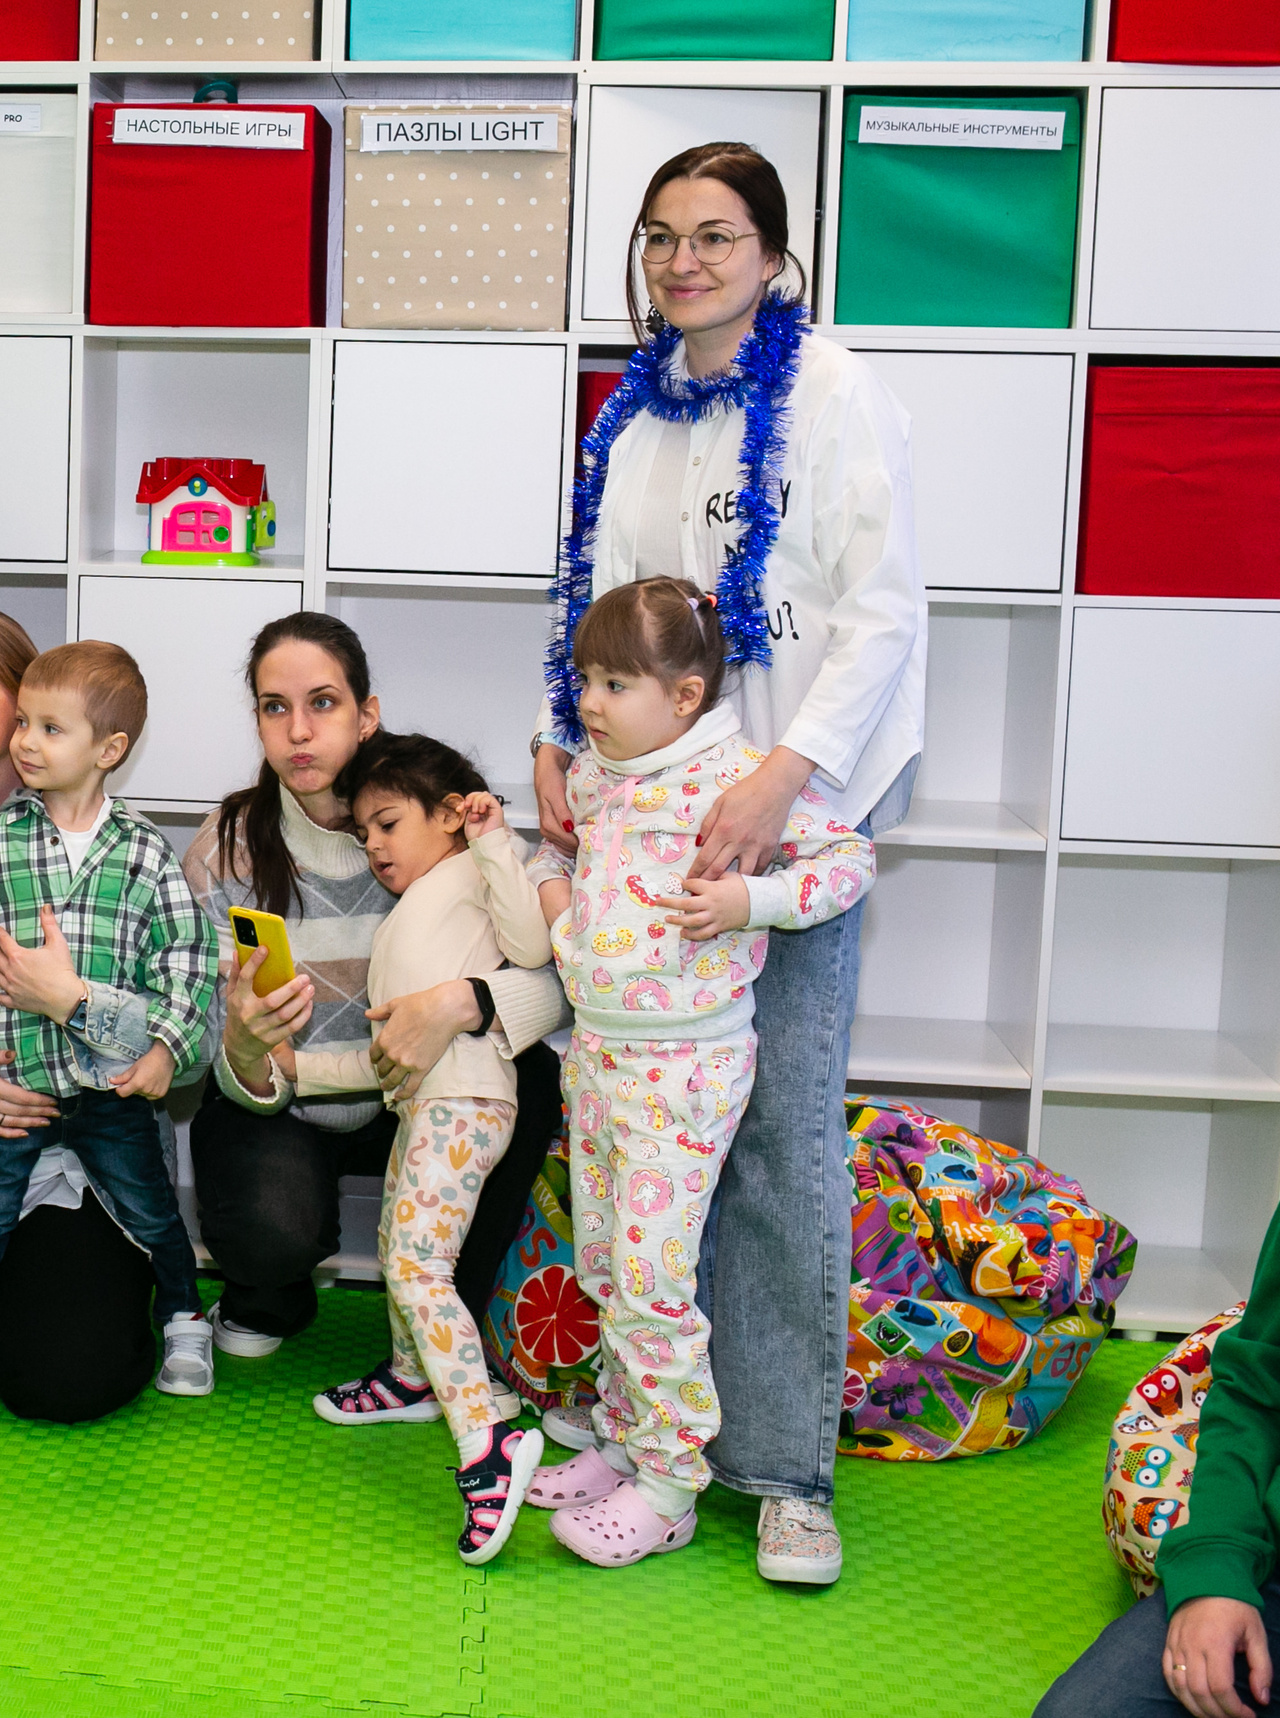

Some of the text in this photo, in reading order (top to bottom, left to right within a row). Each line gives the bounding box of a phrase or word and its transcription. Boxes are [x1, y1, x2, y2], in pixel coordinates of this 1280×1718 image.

[3, 114, 23, 123] PRO
[127, 119, 292, 137] НАСТОЛЬНЫЕ ИГРЫ
[376, 121, 545, 142] ПАЗЛЫ LIGHT
[866, 121, 1057, 137] МУЗЫКАЛЬНЫЕ ИНСТРУМЕНТЫ
